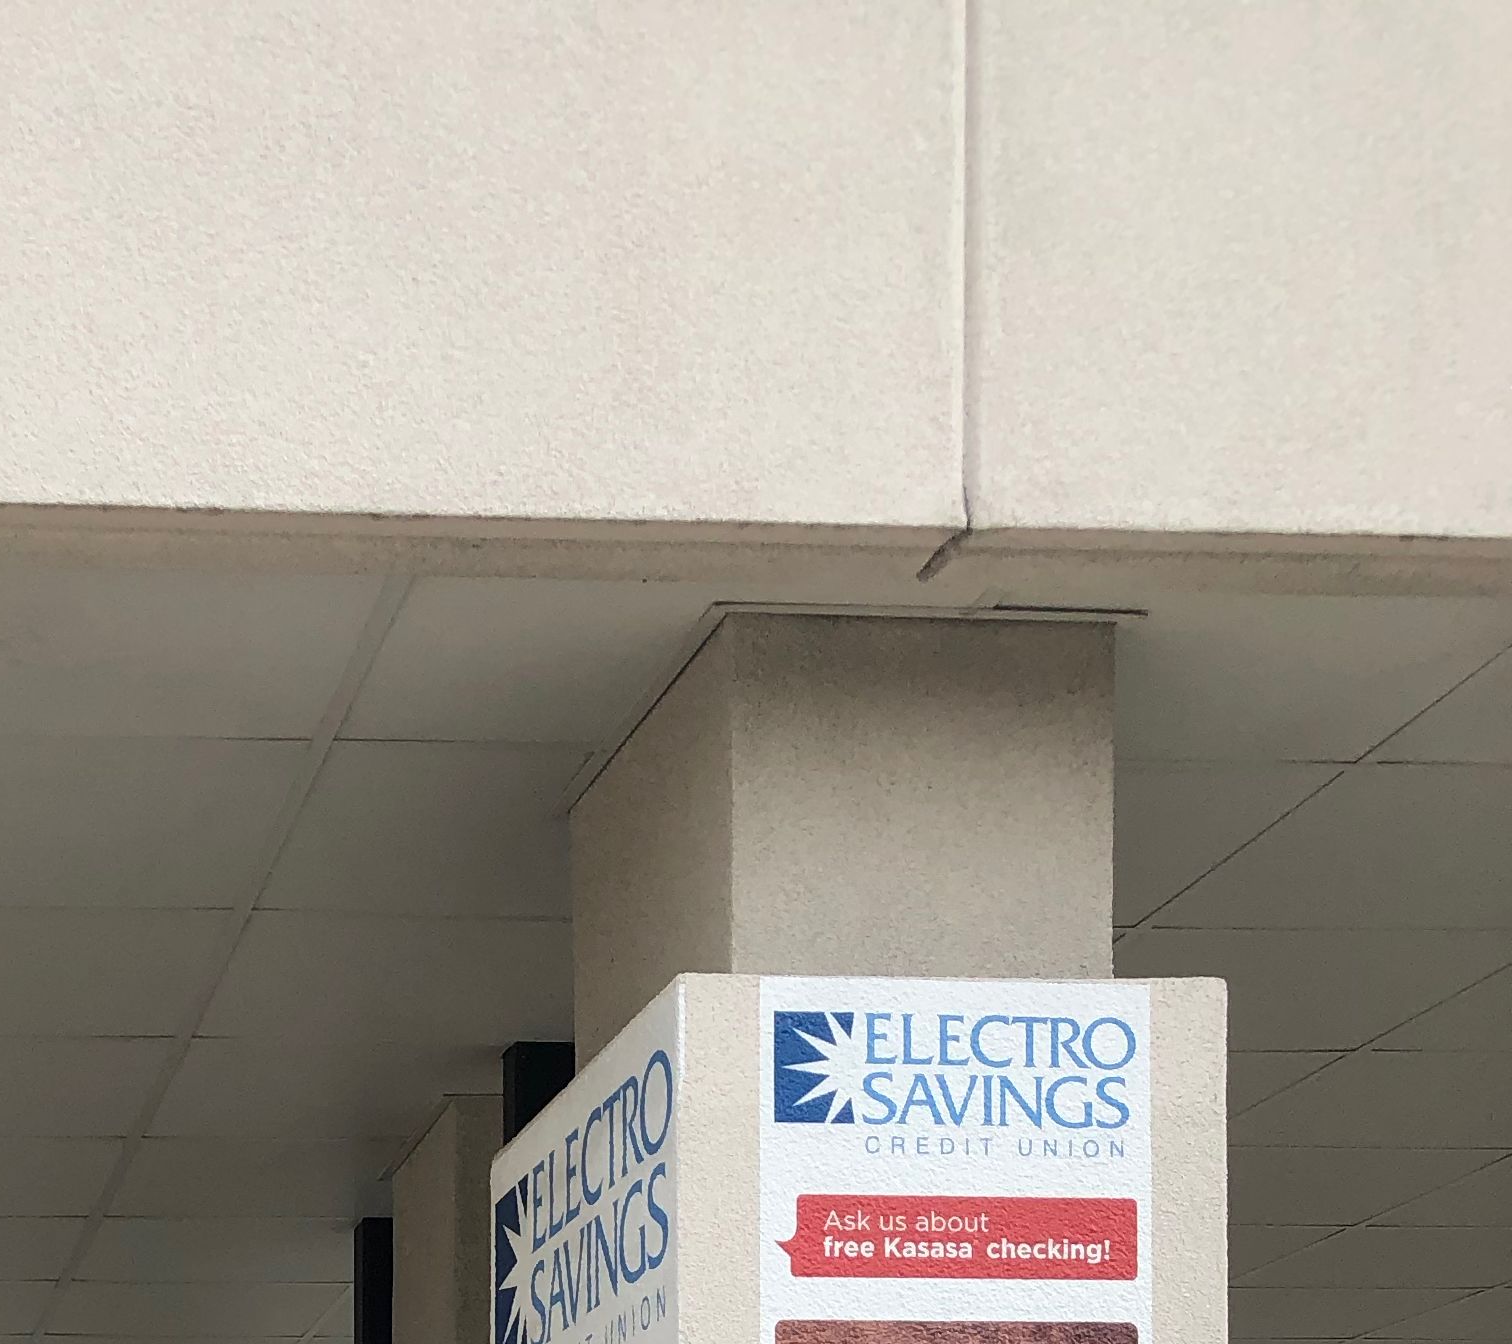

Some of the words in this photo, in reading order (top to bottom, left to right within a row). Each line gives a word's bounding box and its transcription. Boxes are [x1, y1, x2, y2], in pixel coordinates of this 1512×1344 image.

[865, 1012, 1137, 1070] ELECTRO
[863, 1074, 1130, 1129] SAVINGS
[533, 1050, 673, 1254] ELECTRO
[865, 1136, 993, 1157] CREDIT
[1018, 1138, 1125, 1159] UNION
[823, 1211, 871, 1231] Ask
[879, 1215, 907, 1232] us
[916, 1211, 990, 1233] about
[824, 1236, 875, 1257] free
[884, 1237, 973, 1259] Kasasa
[987, 1238, 1112, 1264] checking!
